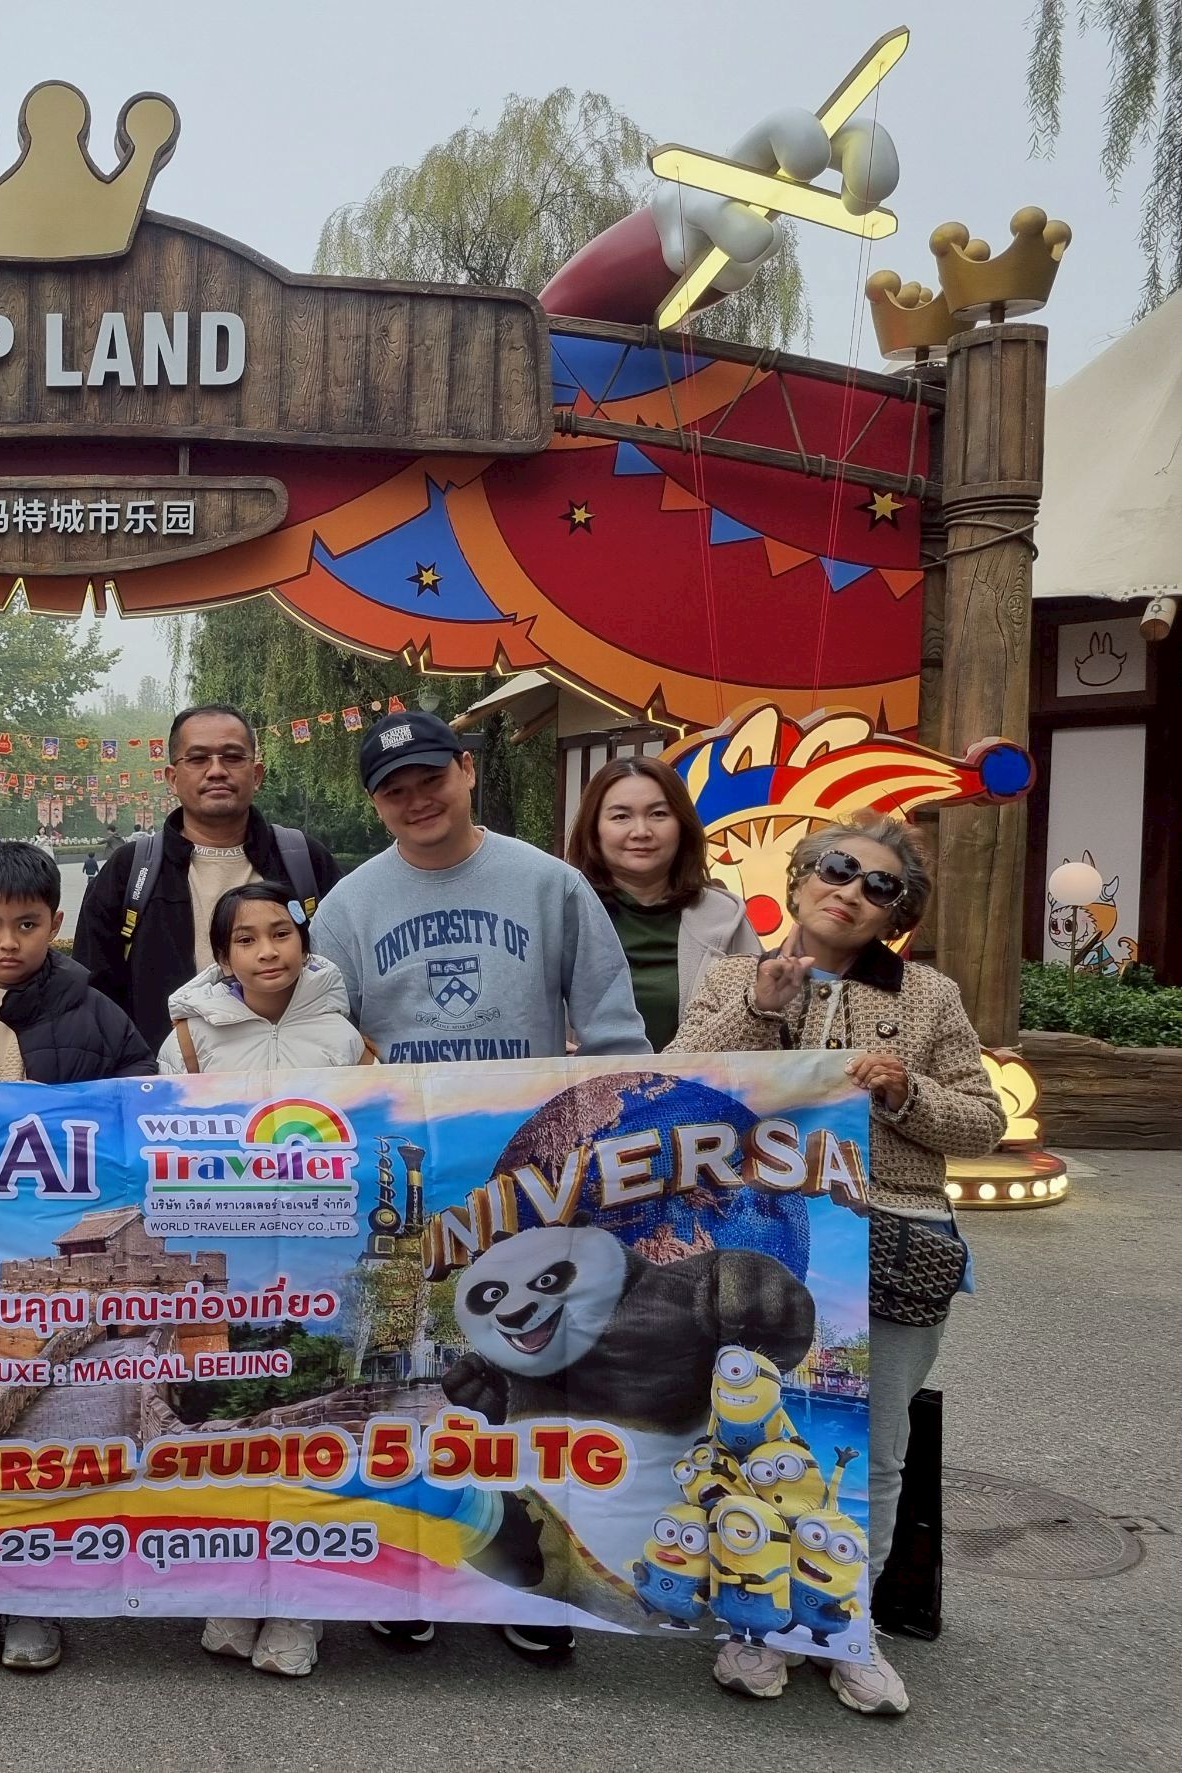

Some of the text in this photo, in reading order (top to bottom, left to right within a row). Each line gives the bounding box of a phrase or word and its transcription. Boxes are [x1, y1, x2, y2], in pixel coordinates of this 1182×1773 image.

[46, 311, 246, 388] LAND
[374, 909, 530, 977] UNIVERSITY OF
[144, 1119, 242, 1136] WORLD
[146, 1151, 352, 1180] Traveller
[150, 1194, 351, 1211] บริษัท เวิลด์ ทราเวลเลอร์ เอเจนซี่ จำกัด
[420, 1118, 869, 1282] UNIVERSA
[150, 1221, 353, 1232] WORLD TRAVELLER AGENCY CO.,LTD.
[100, 1277, 338, 1322] คณะท่องเที่ยว
[73, 1357, 188, 1382] MAGICAL
[198, 1353, 289, 1378] BEIJING
[147, 1432, 347, 1480] STUDIO
[368, 1426, 414, 1480] 5
[429, 1416, 517, 1480] วัน
[533, 1428, 627, 1486] TG
[143, 1531, 255, 1571] ตุลาคม
[272, 1525, 374, 1558] 2025
